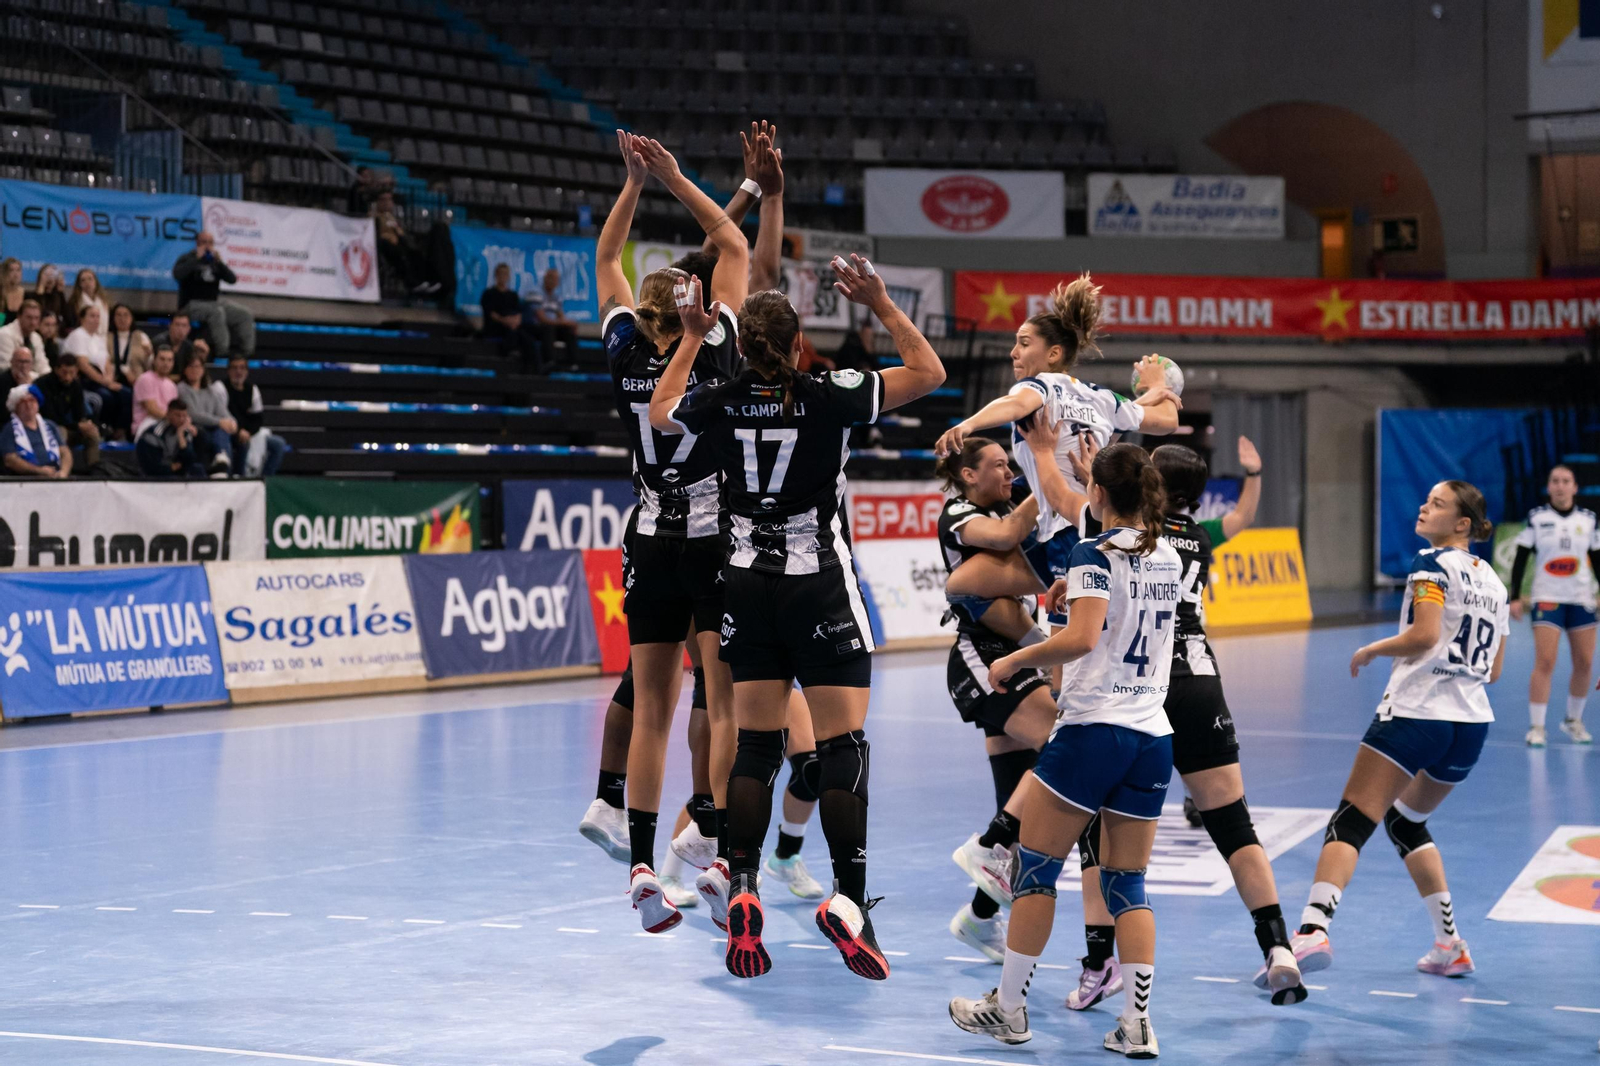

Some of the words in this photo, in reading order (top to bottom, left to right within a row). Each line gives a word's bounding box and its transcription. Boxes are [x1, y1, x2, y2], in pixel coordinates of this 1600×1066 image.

[1172, 176, 1247, 200] Badia
[1151, 201, 1280, 219] Assegurances
[1178, 297, 1273, 328] DAMM
[1359, 299, 1505, 331] ESTRELLA
[734, 428, 799, 493] 17
[272, 513, 417, 550] COALIMENT
[856, 500, 942, 536] SPAR
[28, 509, 233, 567] hummel
[256, 572, 366, 592] AUTOCARS
[1223, 550, 1301, 590] FRAIKIN
[224, 602, 413, 649] Sagalés
[440, 574, 570, 653] Agbar
[55, 659, 105, 687] MÚTUA
[107, 660, 127, 683] DE
[128, 654, 214, 681] GRANOLLERS
